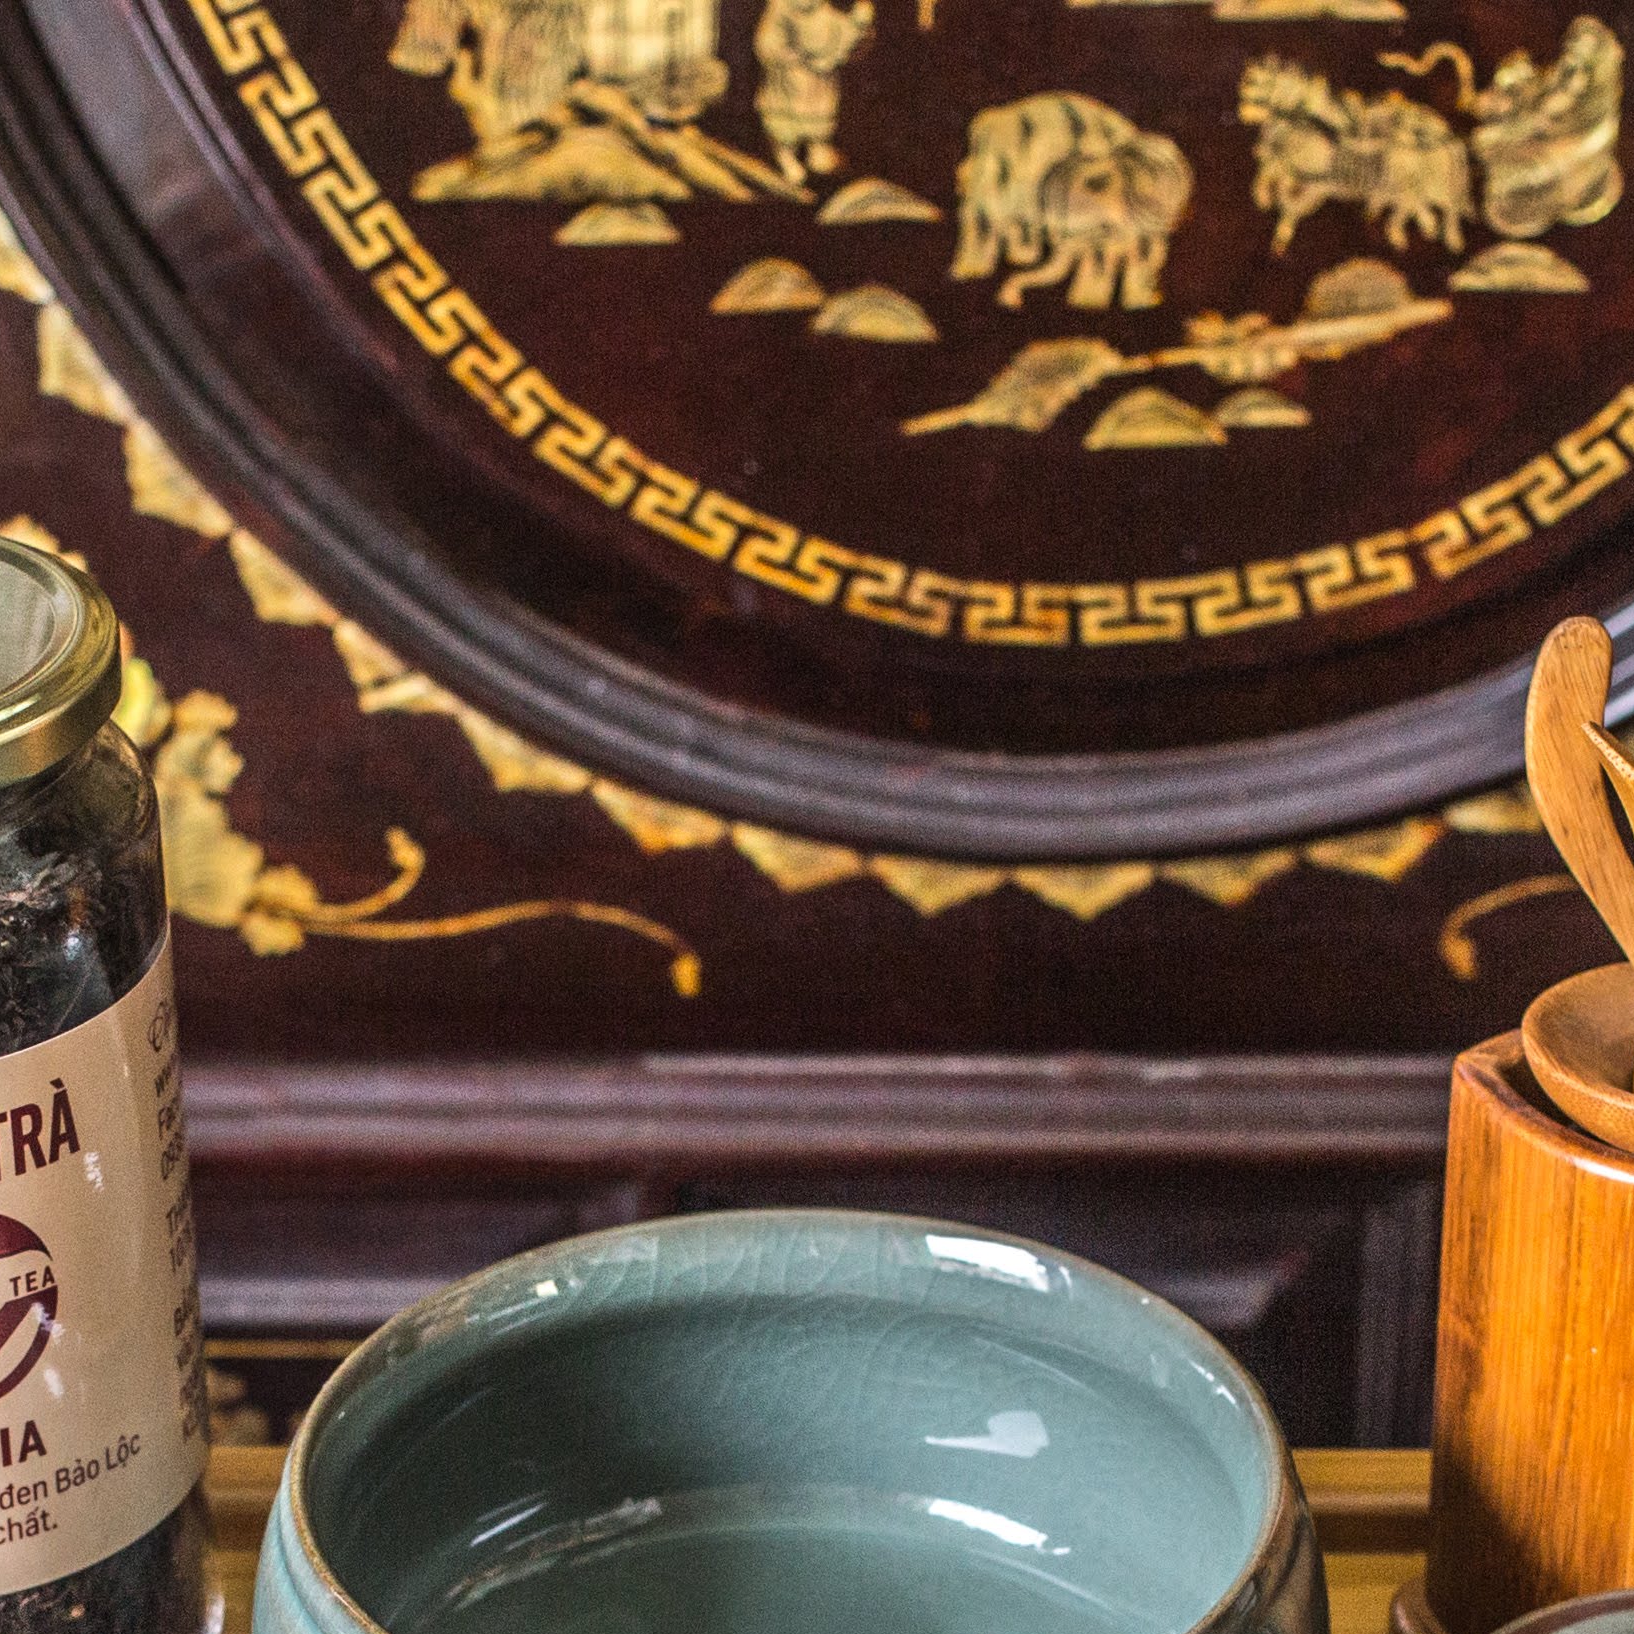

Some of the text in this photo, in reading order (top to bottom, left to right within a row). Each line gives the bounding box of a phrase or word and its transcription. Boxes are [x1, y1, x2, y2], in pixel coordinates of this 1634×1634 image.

[9, 1265, 55, 1297] TEA
[56, 1458, 101, 1495] Bảo
[105, 1432, 142, 1472] Lộc
